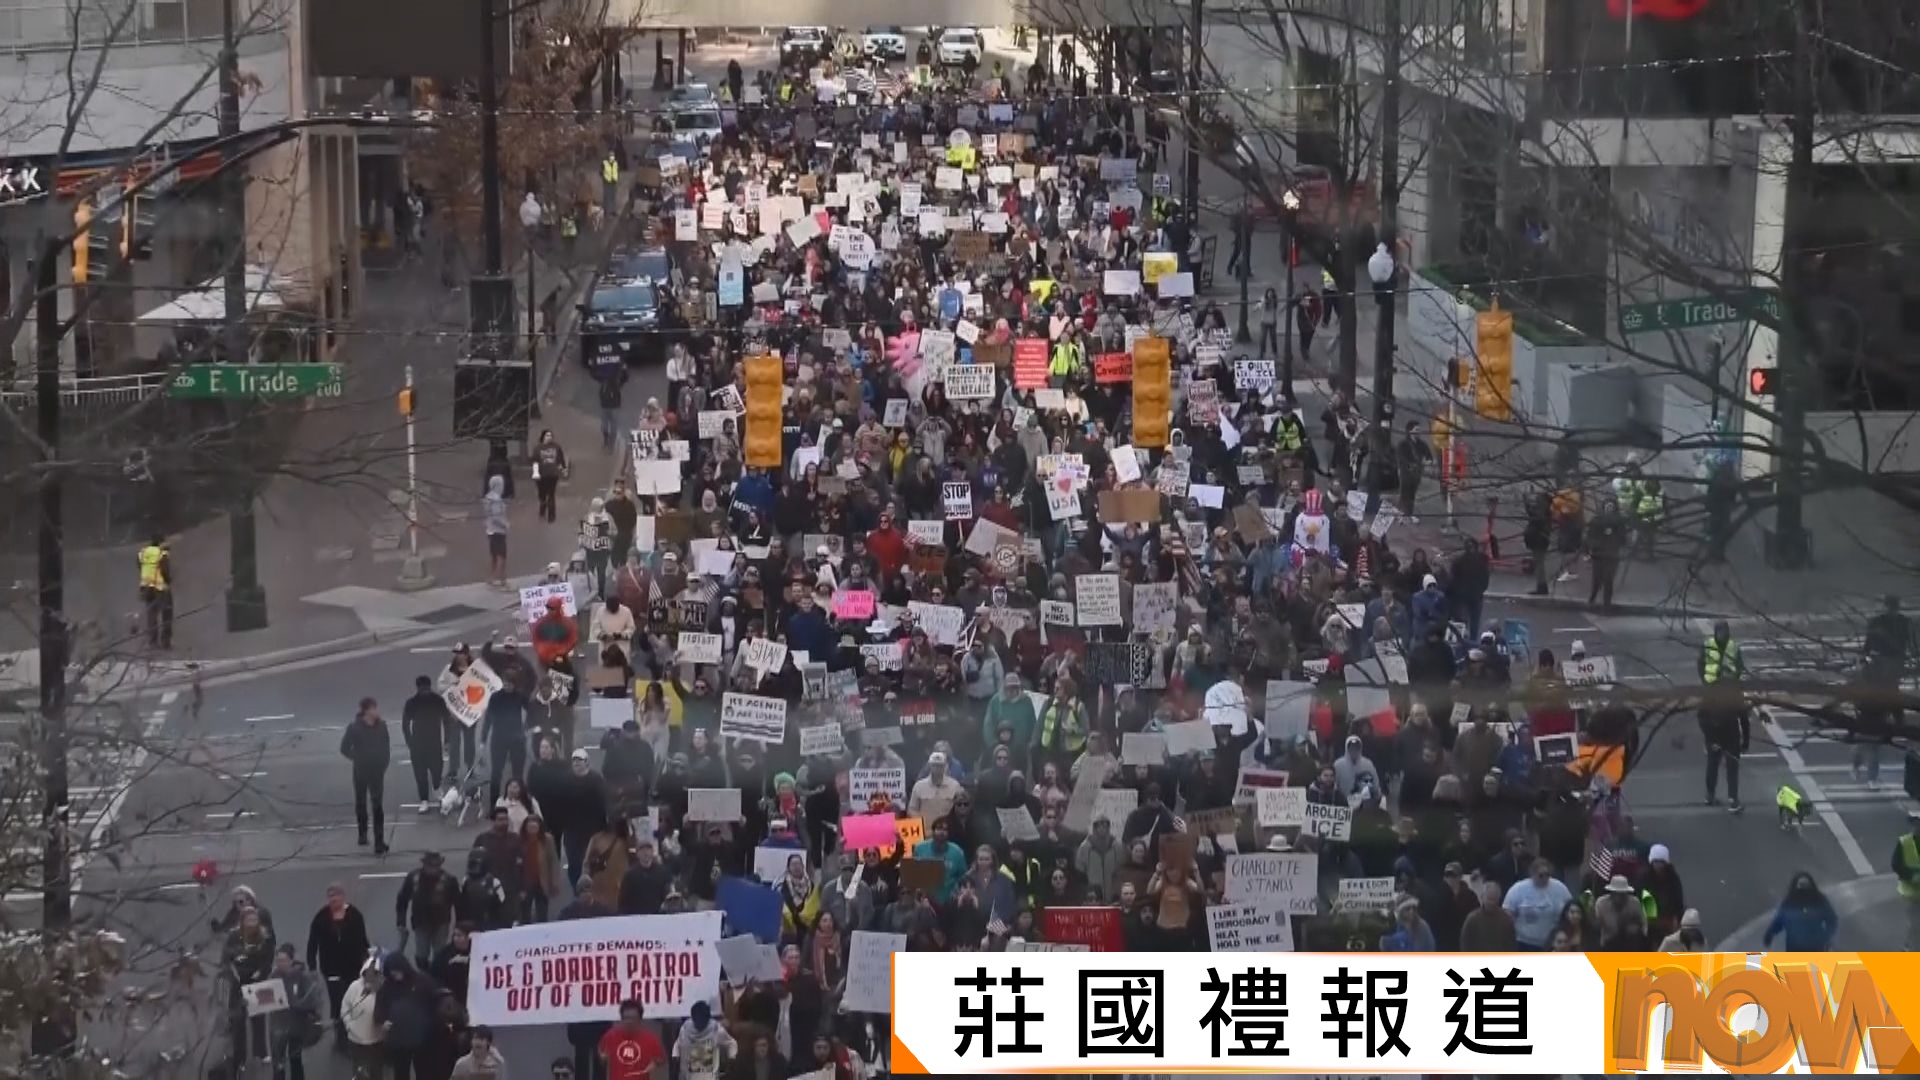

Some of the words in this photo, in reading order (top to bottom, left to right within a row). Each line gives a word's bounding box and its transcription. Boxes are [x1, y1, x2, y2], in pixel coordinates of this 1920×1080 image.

[237, 369, 299, 394] Trade
[943, 484, 970, 500] STOP
[1049, 482, 1055, 491] I
[1051, 495, 1077, 511] USA
[525, 588, 543, 599] SHE
[549, 583, 568, 594] WAS
[1051, 604, 1065, 613] NO
[1045, 613, 1070, 623] KINGS
[1578, 664, 1594, 673] NO
[745, 699, 784, 711] AGENTS
[900, 716, 914, 725] FOR
[917, 714, 935, 724] GOOD
[854, 781, 860, 789] A
[863, 781, 878, 789] FIRE
[882, 780, 901, 788] THAT
[852, 793, 867, 801] WILL
[891, 792, 903, 800] ICE
[1239, 788, 1255, 798] FOR
[1266, 790, 1299, 801] HUMAN
[1305, 803, 1351, 823] ABOLISH
[1311, 819, 1343, 838] ICE
[1231, 858, 1301, 877] CHARLOTTE
[1245, 878, 1294, 894] STANDS
[1218, 909, 1237, 920] LIKE
[1243, 906, 1257, 916] MY
[1214, 914, 1271, 929] DEMOCRACY
[1215, 930, 1240, 940] NEAT
[514, 942, 593, 959] CHARLOTTE
[597, 939, 667, 952] DEMANDS:
[1216, 940, 1240, 950] HOLD
[1245, 937, 1262, 946] THE
[485, 964, 514, 990] ICE
[541, 954, 618, 985] BORDER
[626, 951, 702, 981] PATROL
[506, 986, 543, 1012] OUT
[550, 983, 574, 1008] OF
[581, 980, 623, 1008] OUR
[631, 977, 684, 1006] CITY!
